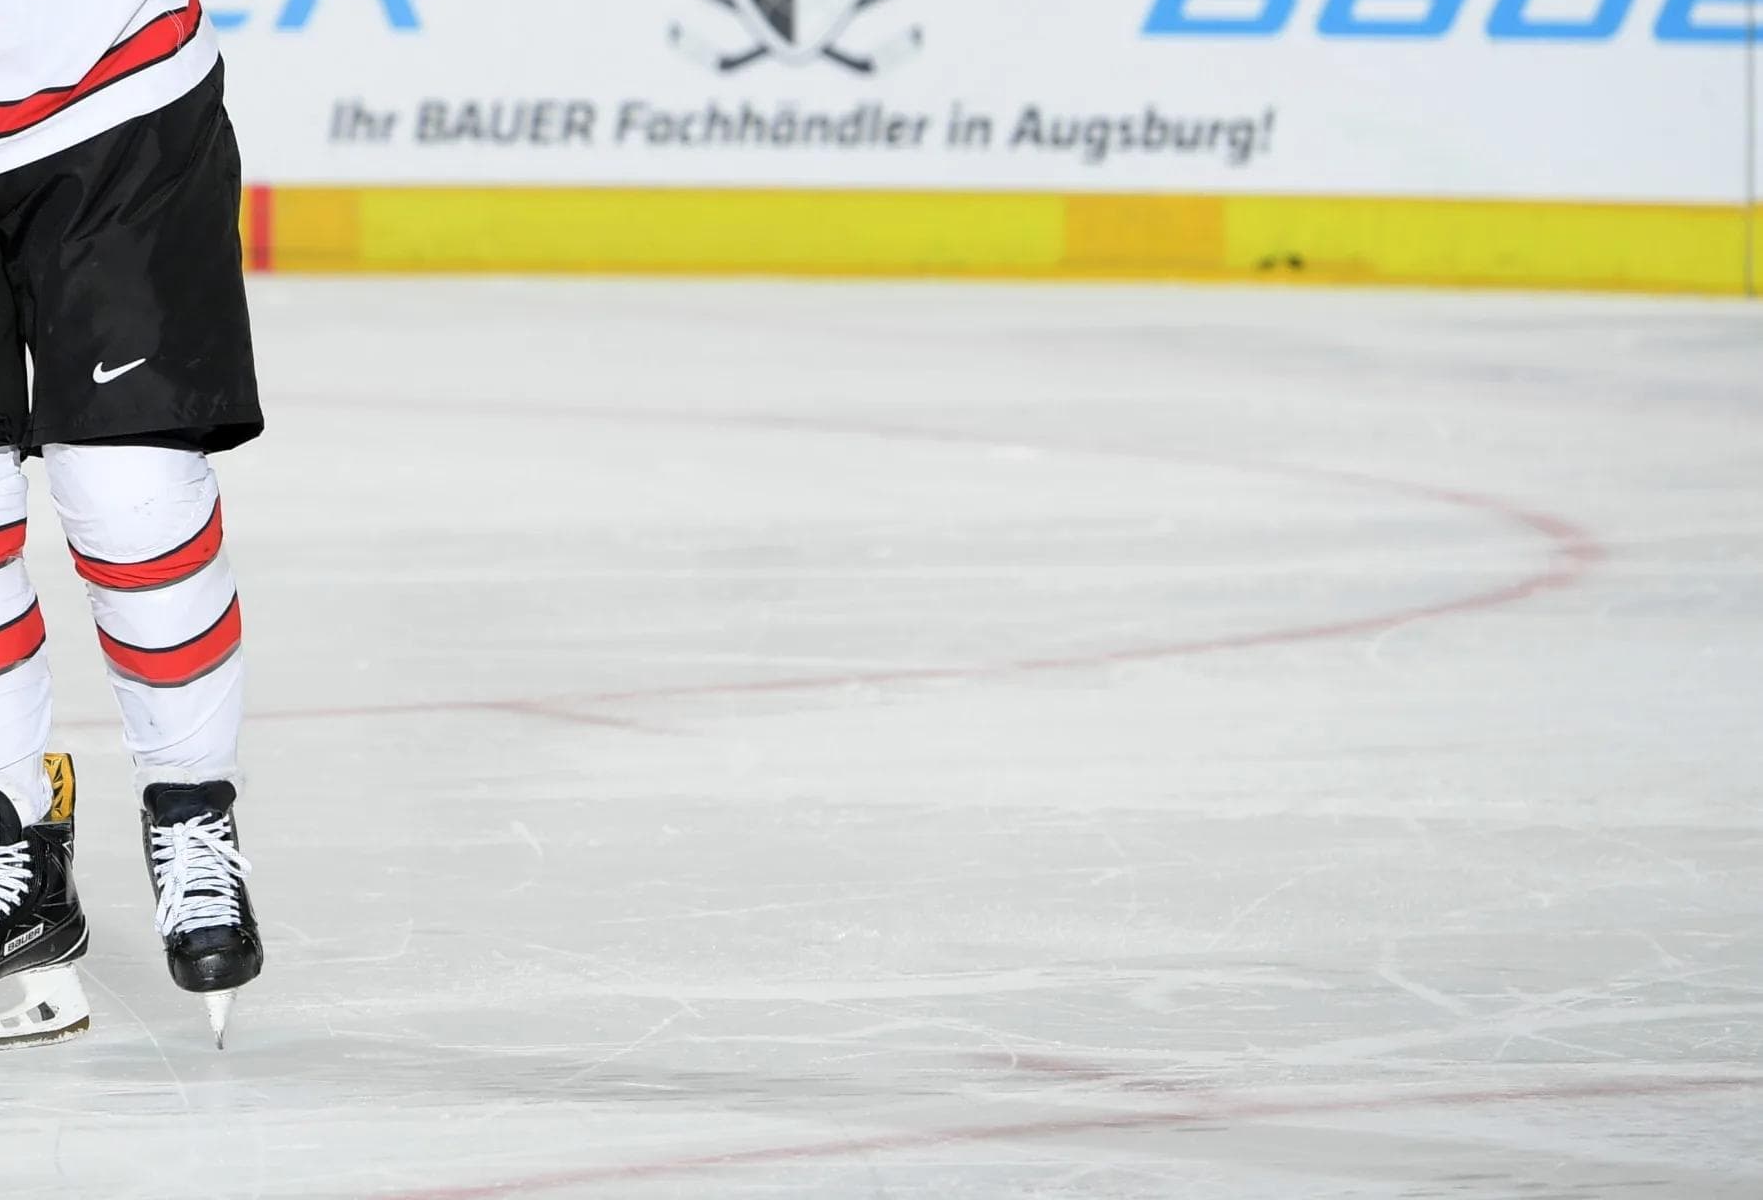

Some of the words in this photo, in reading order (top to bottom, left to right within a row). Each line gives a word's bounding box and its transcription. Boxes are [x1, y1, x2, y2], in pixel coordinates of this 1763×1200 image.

[329, 102, 398, 142] Ihr
[414, 102, 596, 146] BAUER
[614, 100, 930, 150] Fachhändler
[946, 104, 993, 149] in
[1010, 103, 1277, 165] Augsburg!
